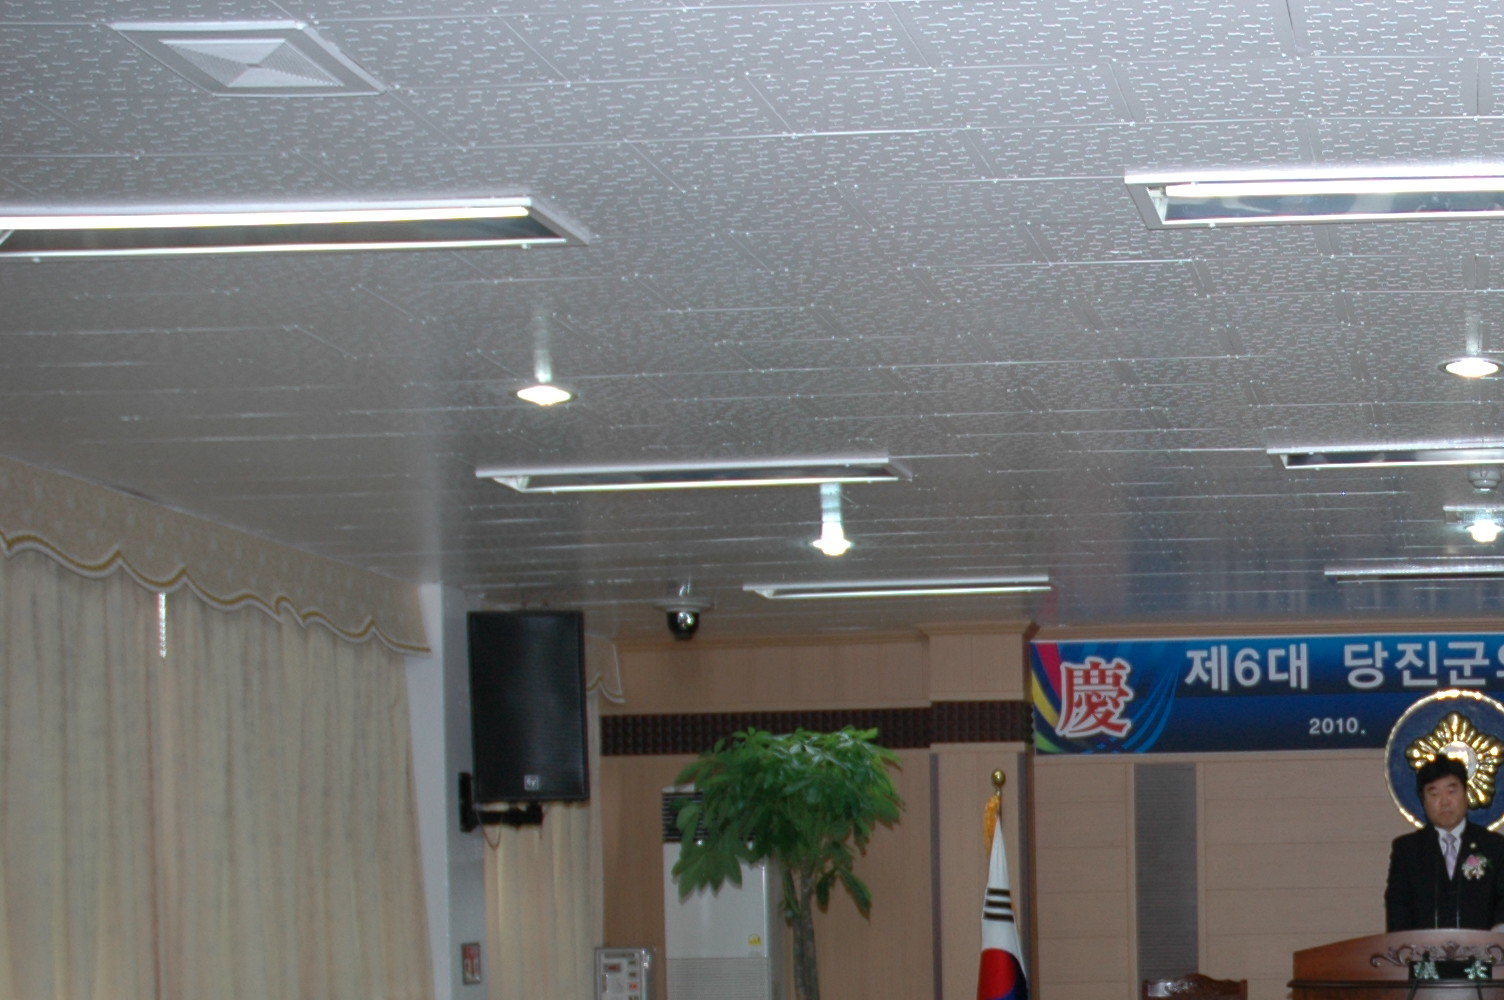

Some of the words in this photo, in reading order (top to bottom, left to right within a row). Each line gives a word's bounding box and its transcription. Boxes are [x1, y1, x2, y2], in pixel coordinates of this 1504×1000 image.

[1184, 643, 1309, 691] 제6대
[1056, 655, 1133, 737] 慶
[1309, 717, 1366, 735] 2010.
